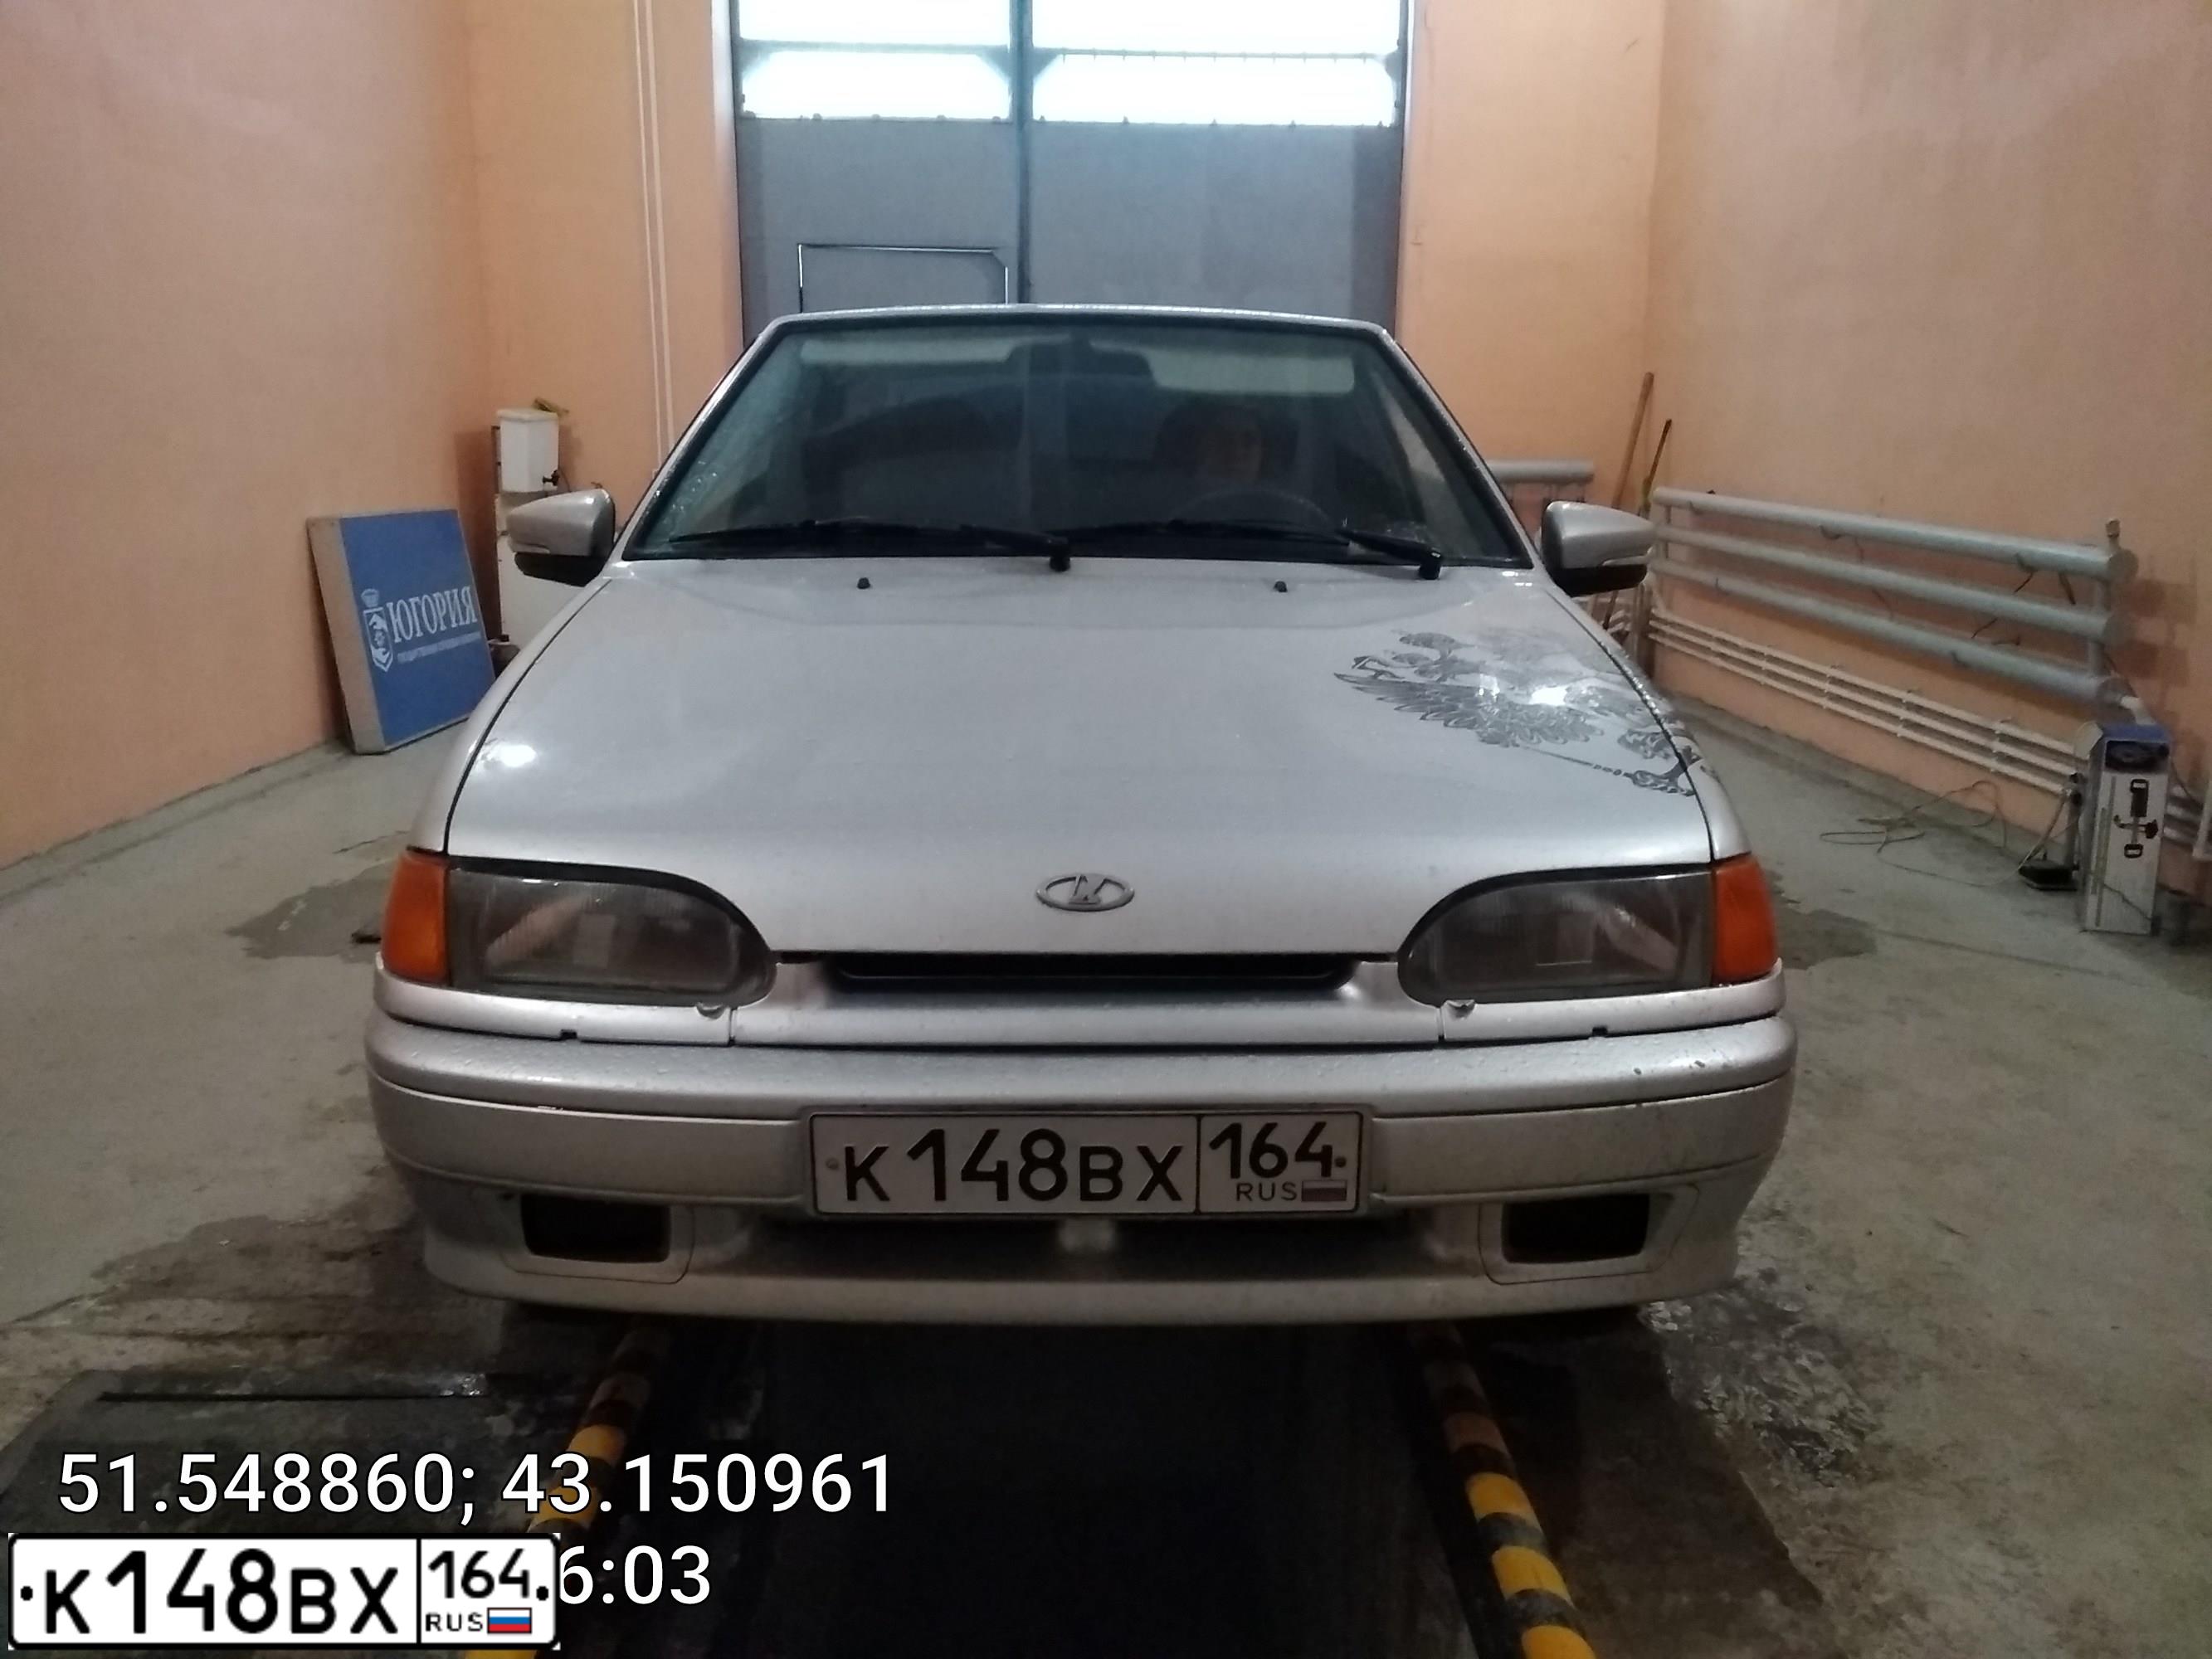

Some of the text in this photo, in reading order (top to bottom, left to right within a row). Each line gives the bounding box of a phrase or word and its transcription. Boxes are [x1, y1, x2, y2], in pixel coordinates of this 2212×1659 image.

[386, 586, 478, 644] ЮГОРИЯ
[844, 1128, 1183, 1202] К148ВХ
[1209, 1121, 1333, 1180] 164
[1235, 1182, 1298, 1202] RUS
